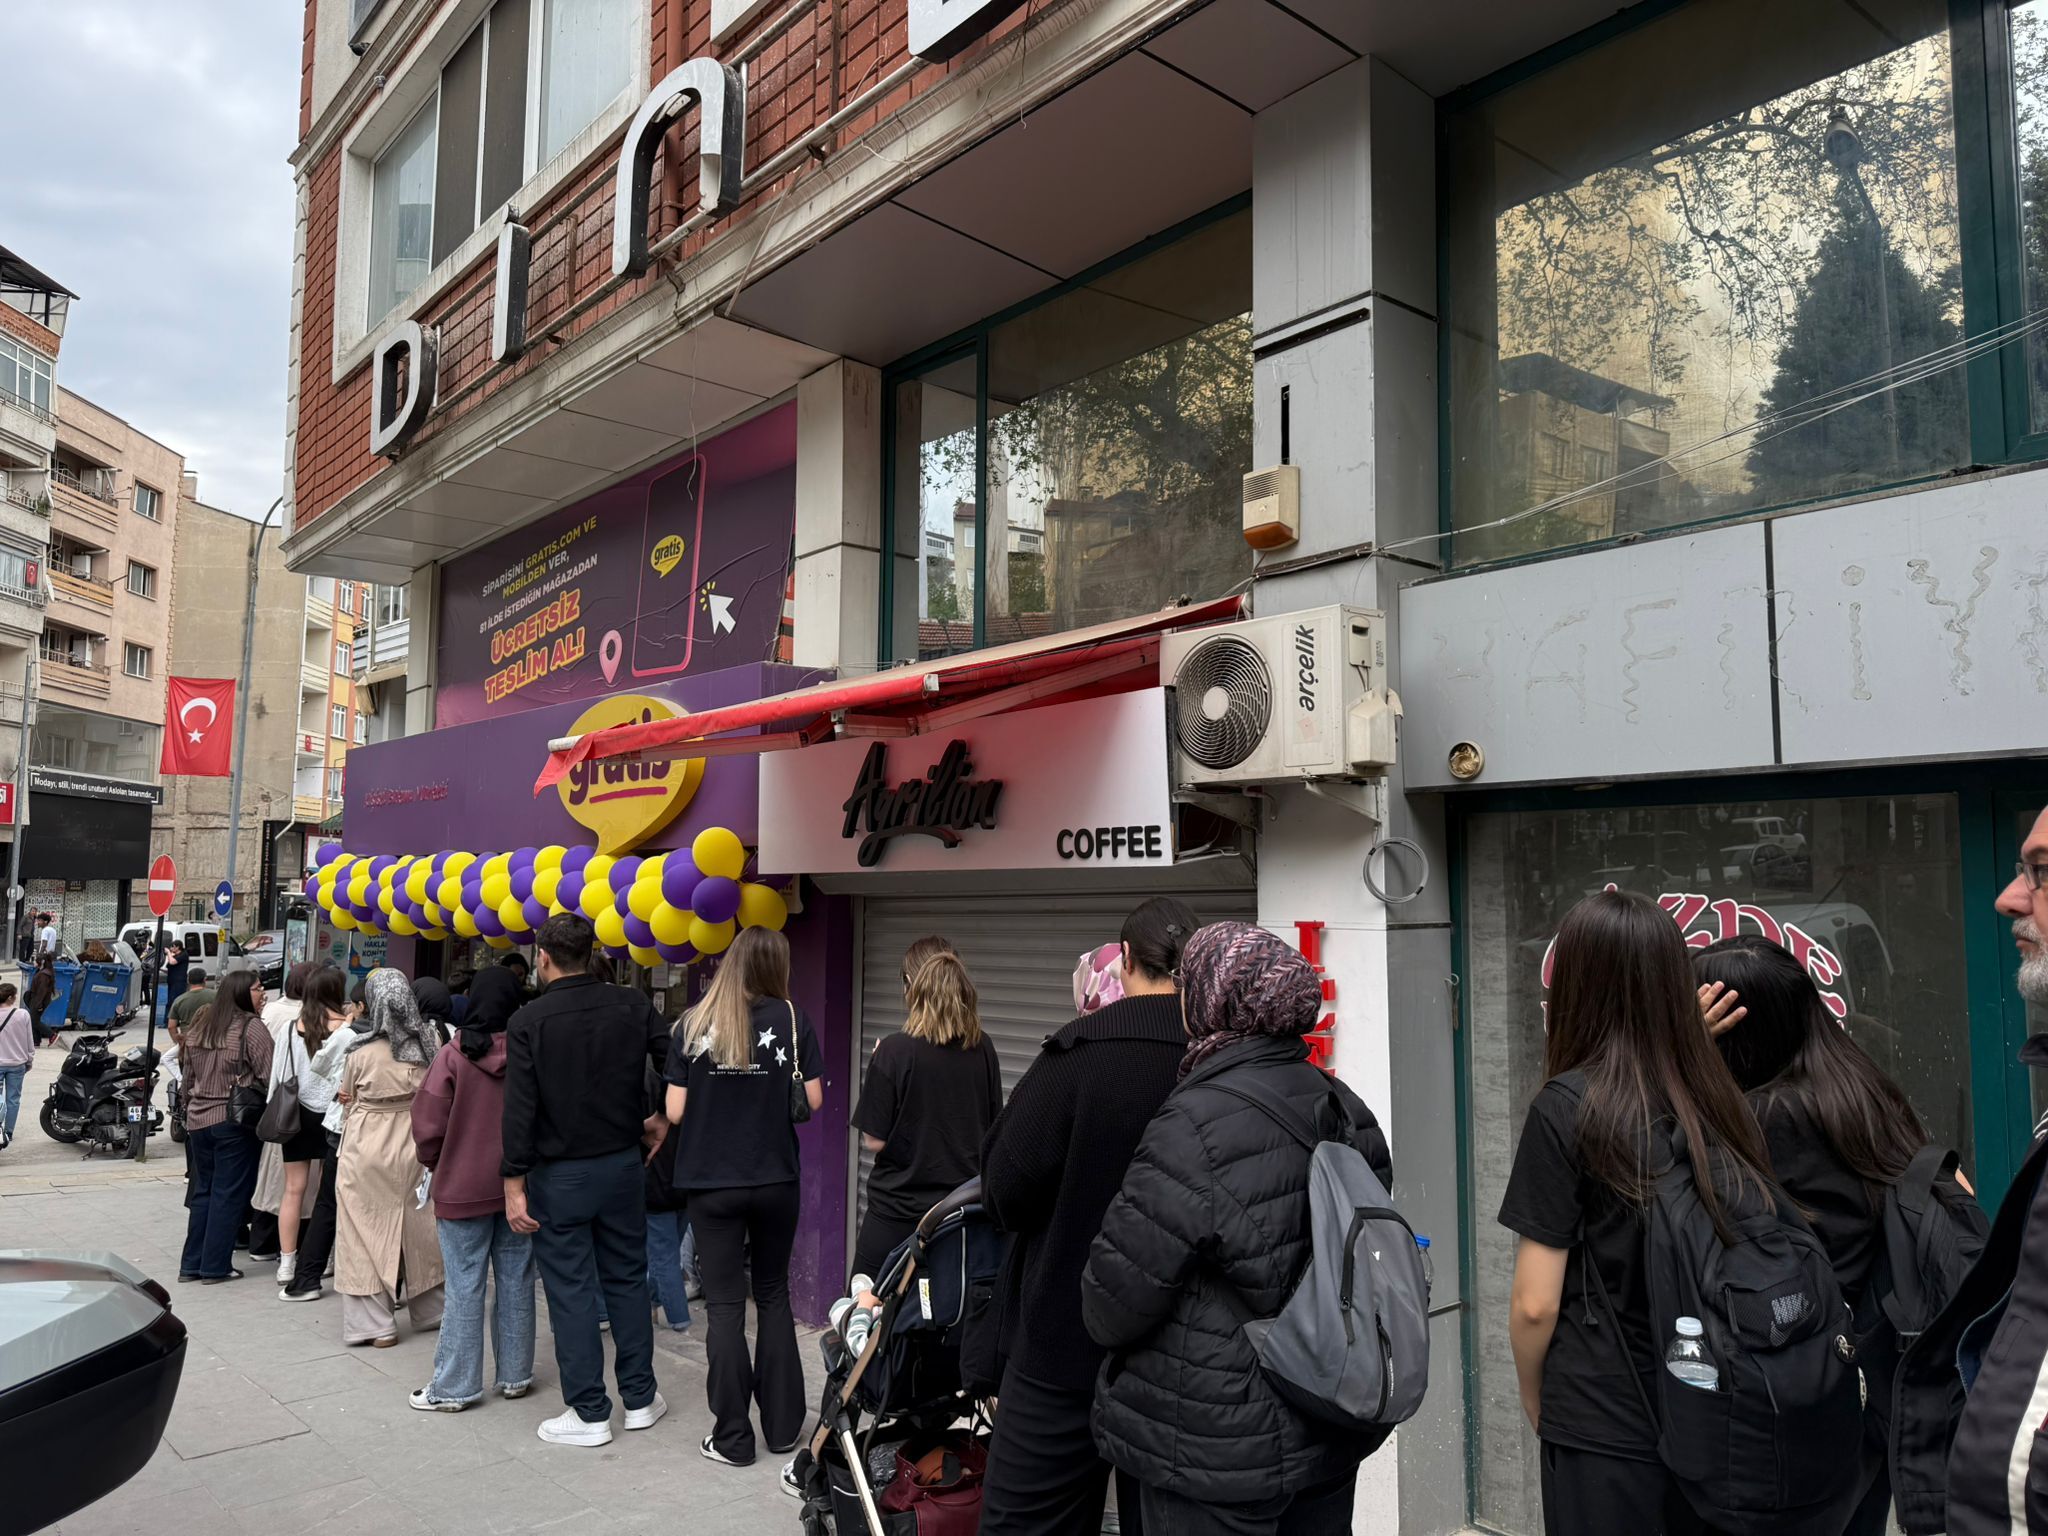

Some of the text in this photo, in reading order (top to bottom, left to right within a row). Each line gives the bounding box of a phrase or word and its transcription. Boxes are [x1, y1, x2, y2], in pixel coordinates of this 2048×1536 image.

[483, 558, 524, 597] SİPARİŞİNİ
[583, 515, 597, 533] VE
[502, 550, 570, 599] MOBİLDEN VER,
[654, 537, 681, 566] gratis
[480, 554, 598, 634] 81 İLDE İSTEDİĞİN MAĞAZADAN
[491, 588, 580, 664] ÜCRETSİZ
[485, 626, 585, 704] TESLİM AL!
[1296, 624, 1319, 712] arçelik
[1056, 825, 1162, 859] COFFEE
